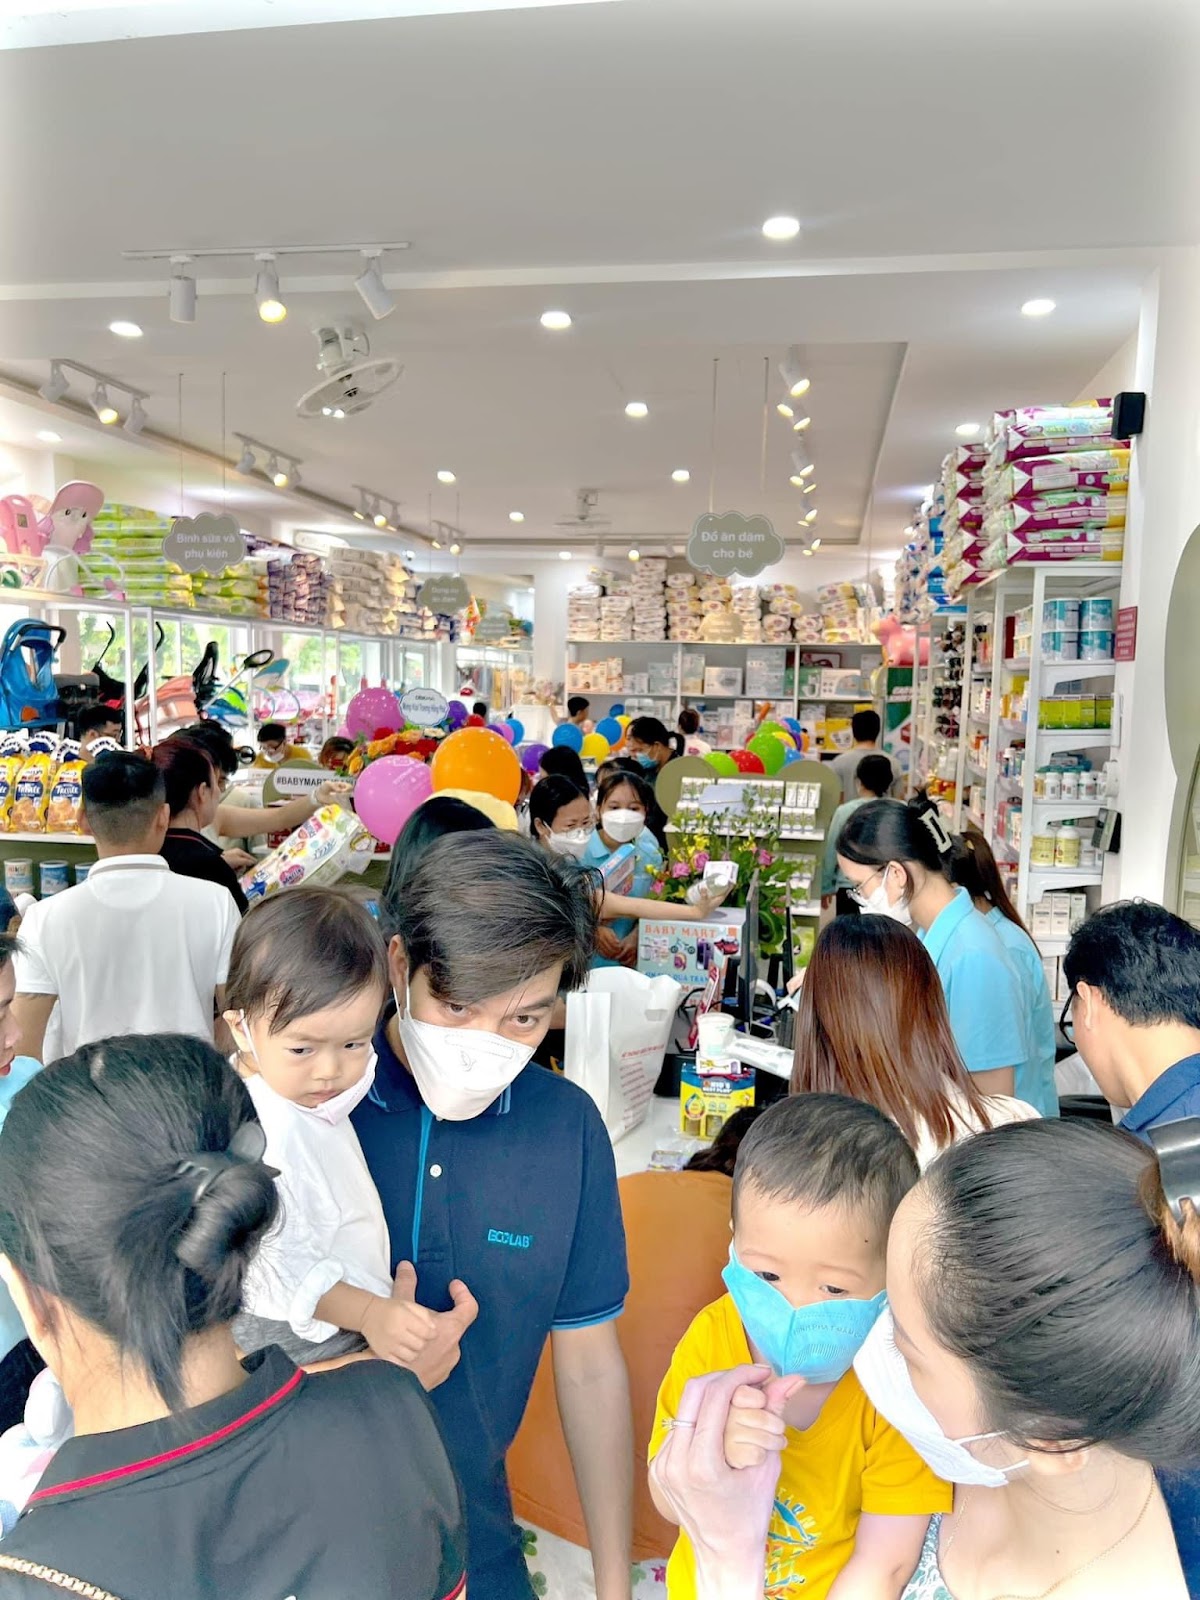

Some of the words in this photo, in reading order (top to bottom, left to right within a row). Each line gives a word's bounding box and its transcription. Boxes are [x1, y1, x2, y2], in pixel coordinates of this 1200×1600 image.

[713, 548, 735, 558] cho
[645, 924, 676, 935] BABY
[682, 927, 717, 938] MART
[487, 1229, 530, 1248] ECOLAB
